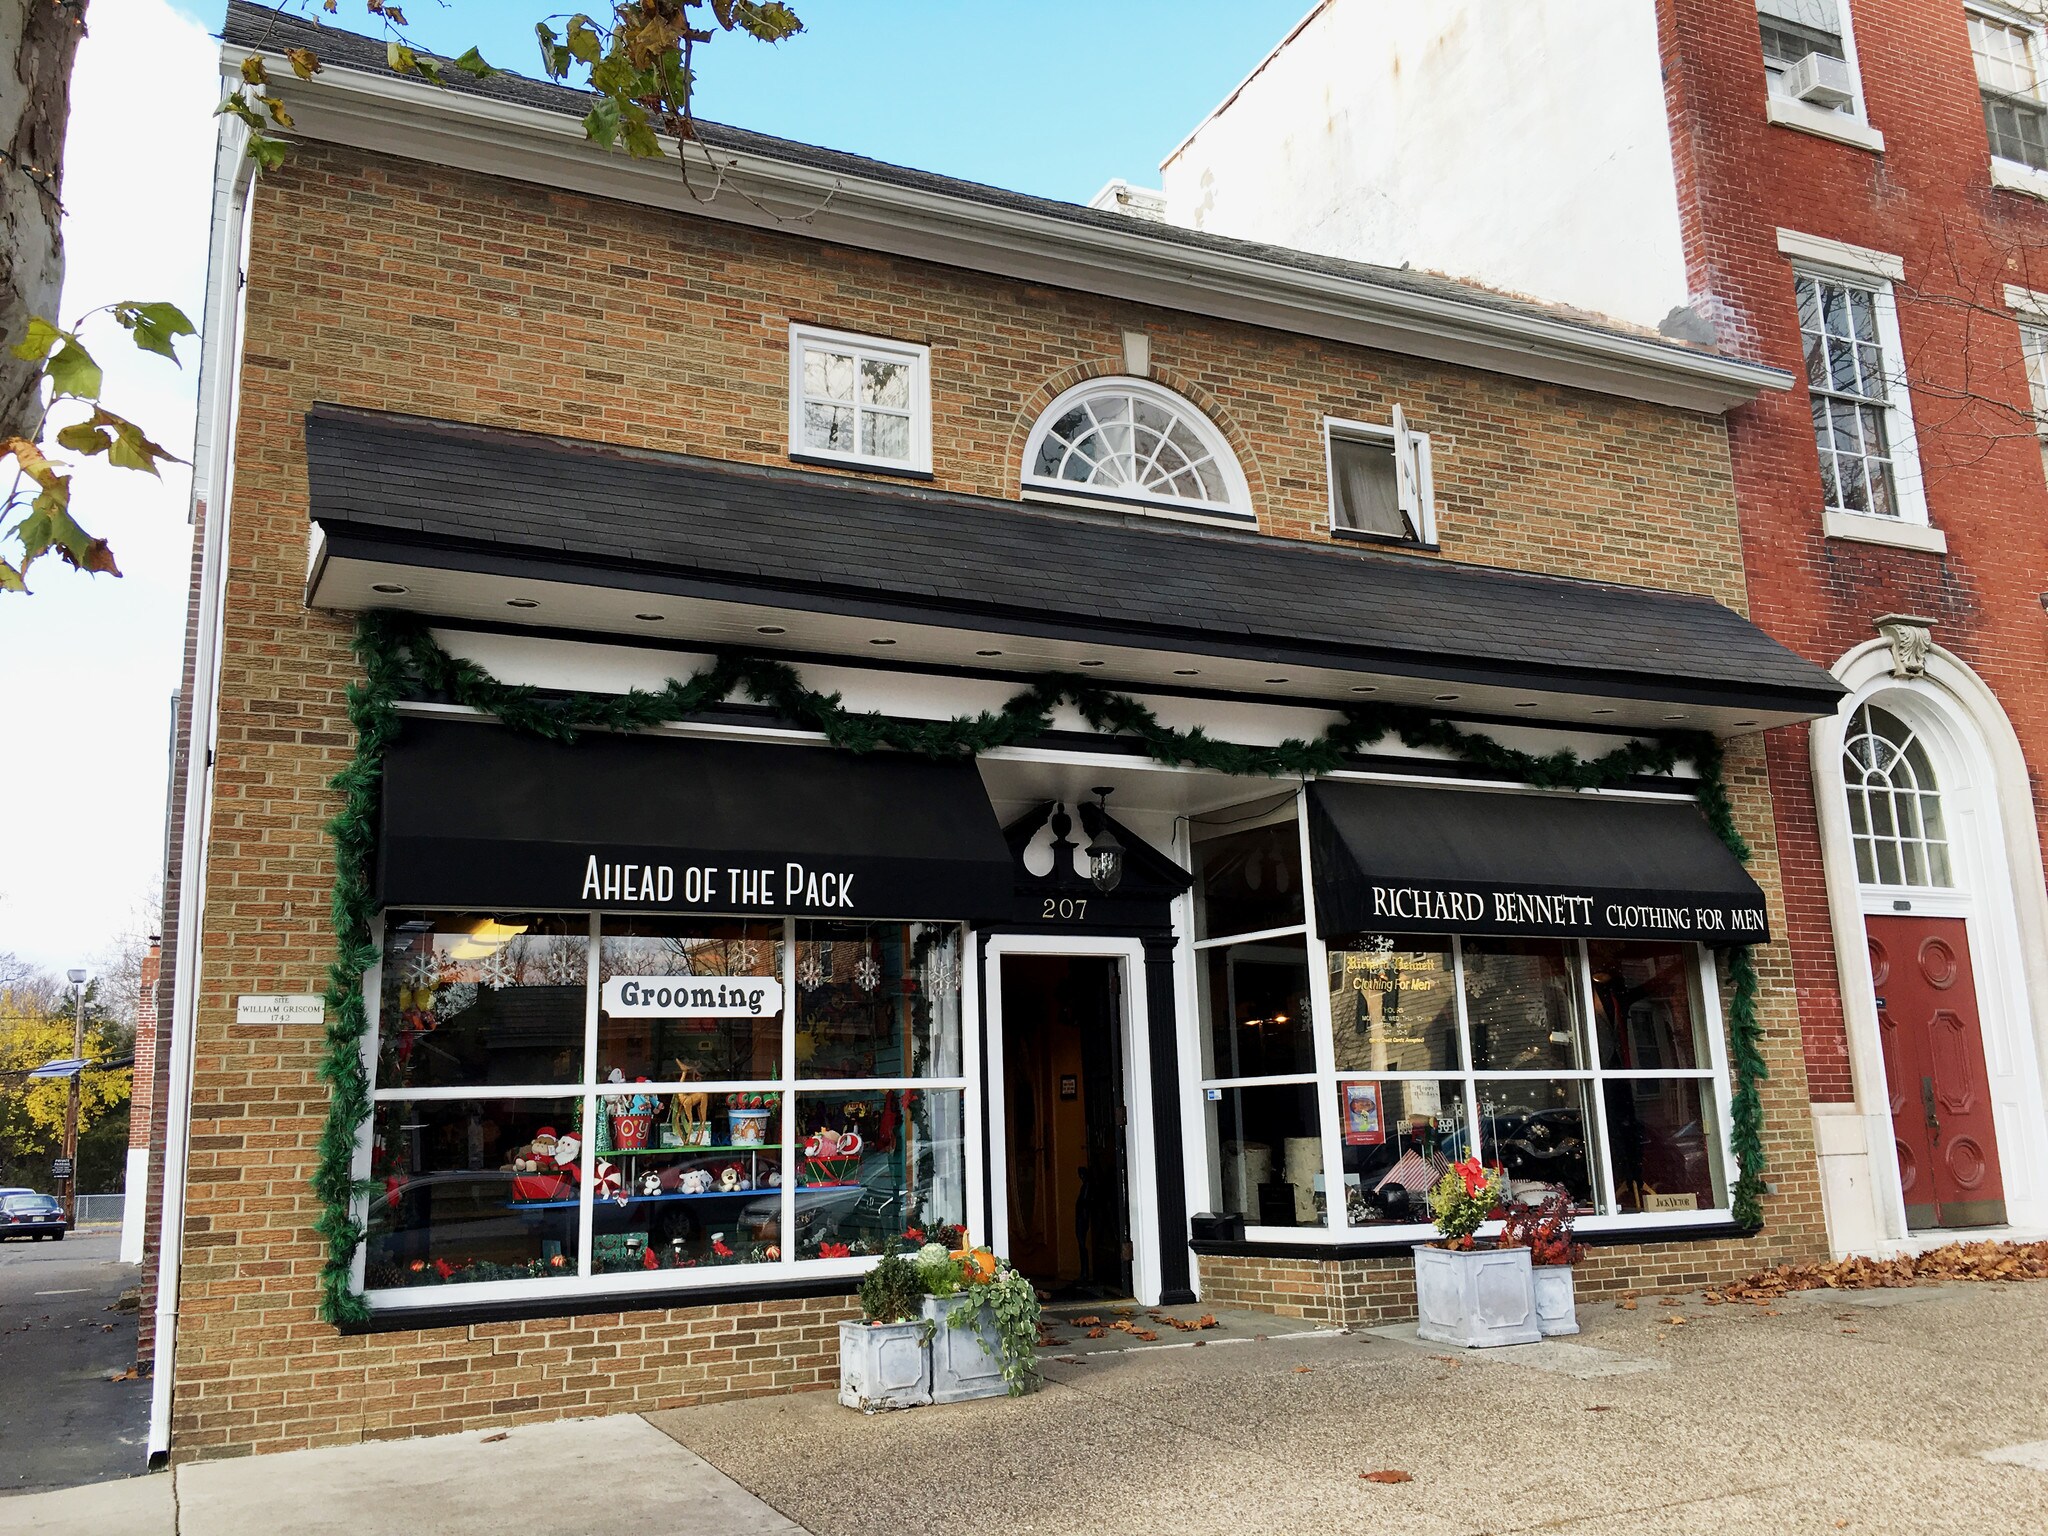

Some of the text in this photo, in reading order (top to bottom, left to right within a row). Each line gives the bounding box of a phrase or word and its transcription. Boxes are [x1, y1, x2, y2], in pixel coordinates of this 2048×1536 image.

[582, 854, 855, 908] AHEAD OF THE PACK
[1042, 898, 1087, 920] 207
[1372, 886, 1765, 931] RICHARD BENNETT CLOTHING FOR MEN
[1353, 977, 1431, 992] Clothing For Men
[242, 1005, 320, 1013] WILLIAM GRISCOM
[620, 981, 765, 1015] Grooming
[270, 1014, 291, 1023] 1742
